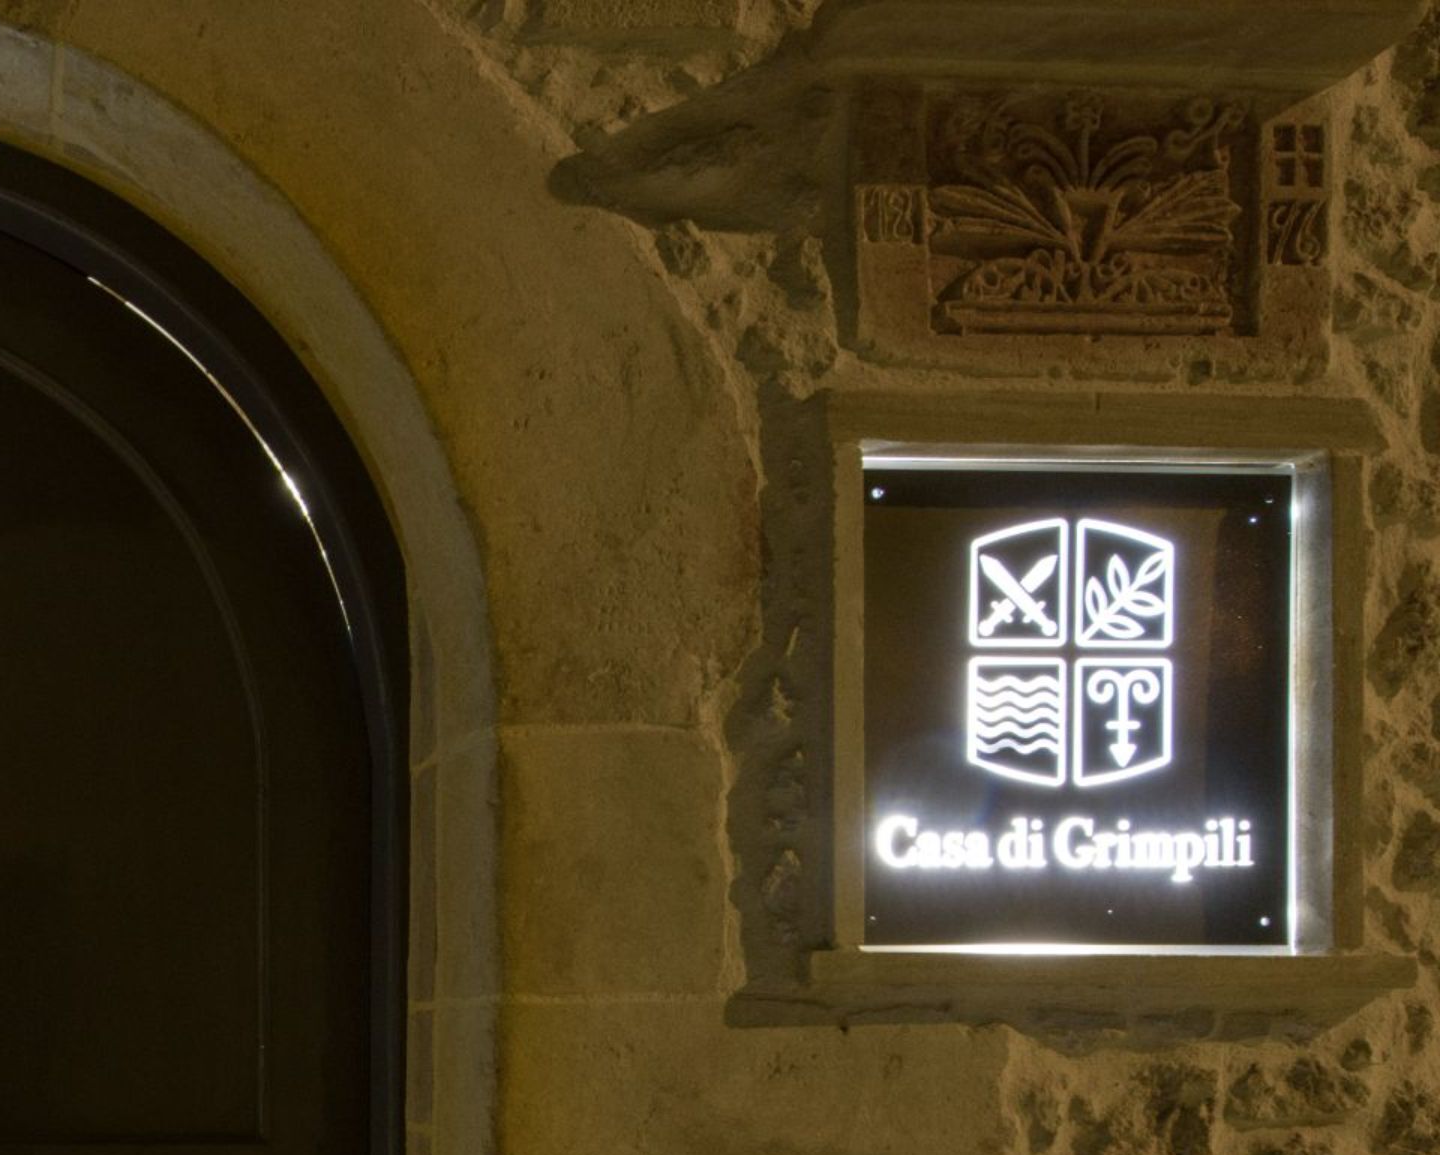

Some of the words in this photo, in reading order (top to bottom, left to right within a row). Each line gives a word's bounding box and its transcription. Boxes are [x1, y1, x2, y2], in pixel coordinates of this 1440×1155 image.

[875, 814, 994, 869] Casa
[997, 816, 1047, 869] di
[1052, 815, 1254, 883] Grimpili
